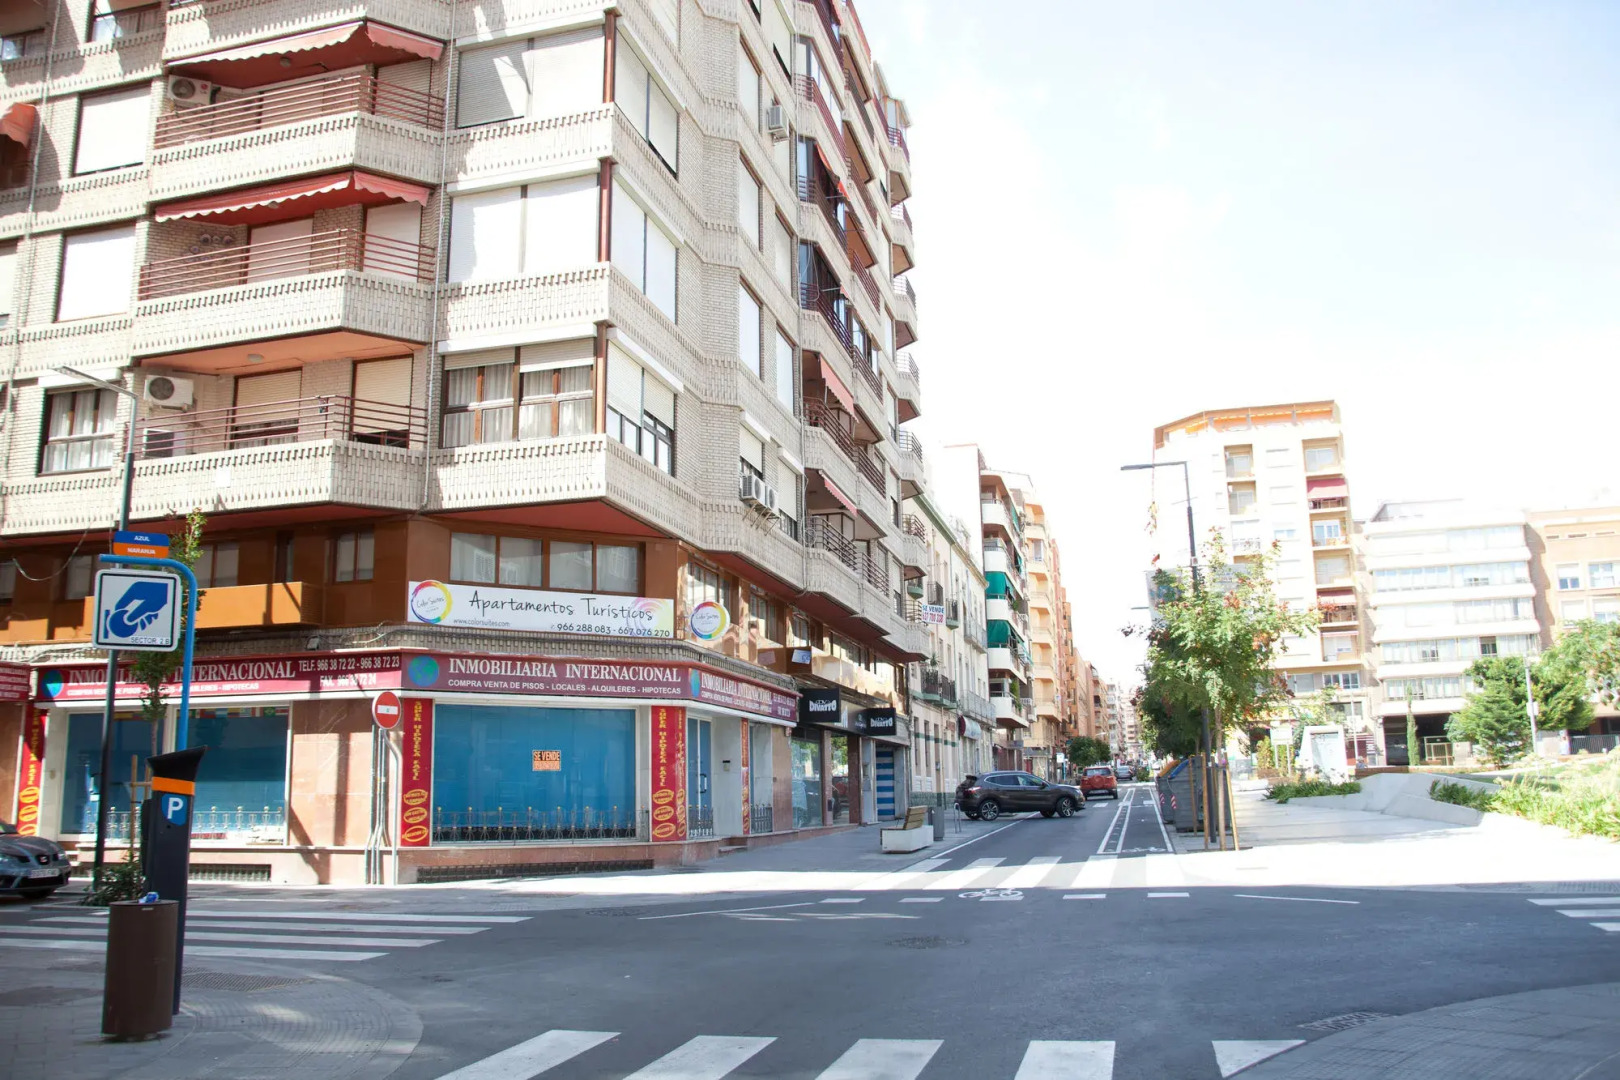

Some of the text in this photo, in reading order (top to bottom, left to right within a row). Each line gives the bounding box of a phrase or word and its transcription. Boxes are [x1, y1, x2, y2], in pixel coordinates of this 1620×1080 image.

[127, 547, 156, 555] NARANJA
[469, 590, 575, 617] Apartamentos
[928, 606, 944, 614] VENDE
[556, 622, 574, 632] 966
[576, 624, 592, 633] 288
[594, 625, 611, 634] 083
[618, 626, 634, 636] 667
[636, 627, 652, 637] 076
[654, 628, 670, 638] 270
[130, 636, 157, 644] SECTOR
[298, 660, 316, 672] TELF.
[316, 658, 328, 671] 966
[330, 658, 338, 670] 38
[338, 658, 346, 670] 72
[347, 658, 356, 670] 22
[360, 657, 372, 669] 966
[382, 656, 390, 668] 72
[391, 656, 400, 668] 23
[449, 658, 681, 682] INMOBILIARIA INTERNACIONAL
[68, 667, 167, 686] INMOILI
[320, 675, 335, 687] FAX.
[448, 679, 482, 687] COMPRA
[484, 680, 508, 688] VENTA
[522, 682, 544, 690] PISOS
[552, 683, 586, 691] LOCALES
[642, 686, 681, 694] HIPOTECAS
[534, 751, 560, 760] SE VENDE
[168, 797, 184, 819] P
